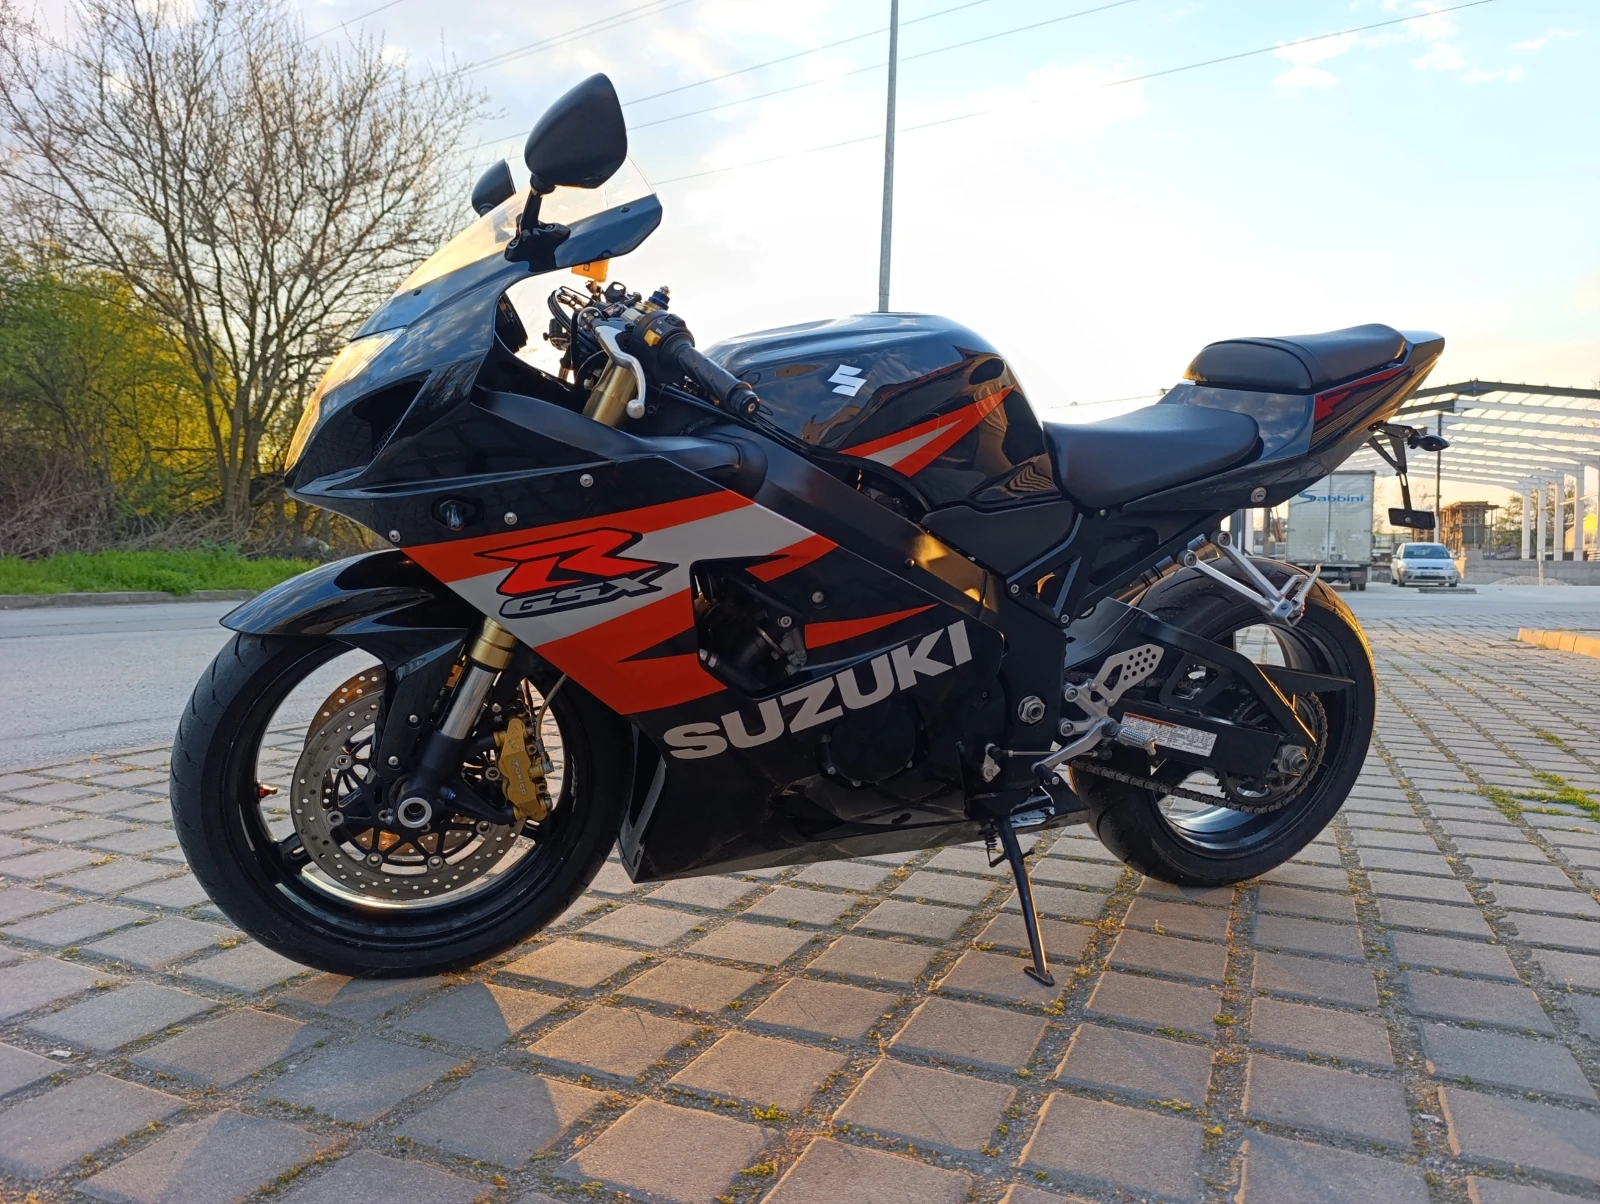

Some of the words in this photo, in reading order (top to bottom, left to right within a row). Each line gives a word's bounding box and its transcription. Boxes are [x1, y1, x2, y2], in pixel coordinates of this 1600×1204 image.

[1296, 489, 1365, 504] Sabbini
[474, 527, 679, 596] R
[499, 568, 662, 619] GSX
[663, 619, 973, 760] SUZUKI
[513, 760, 527, 796] TOKICO
